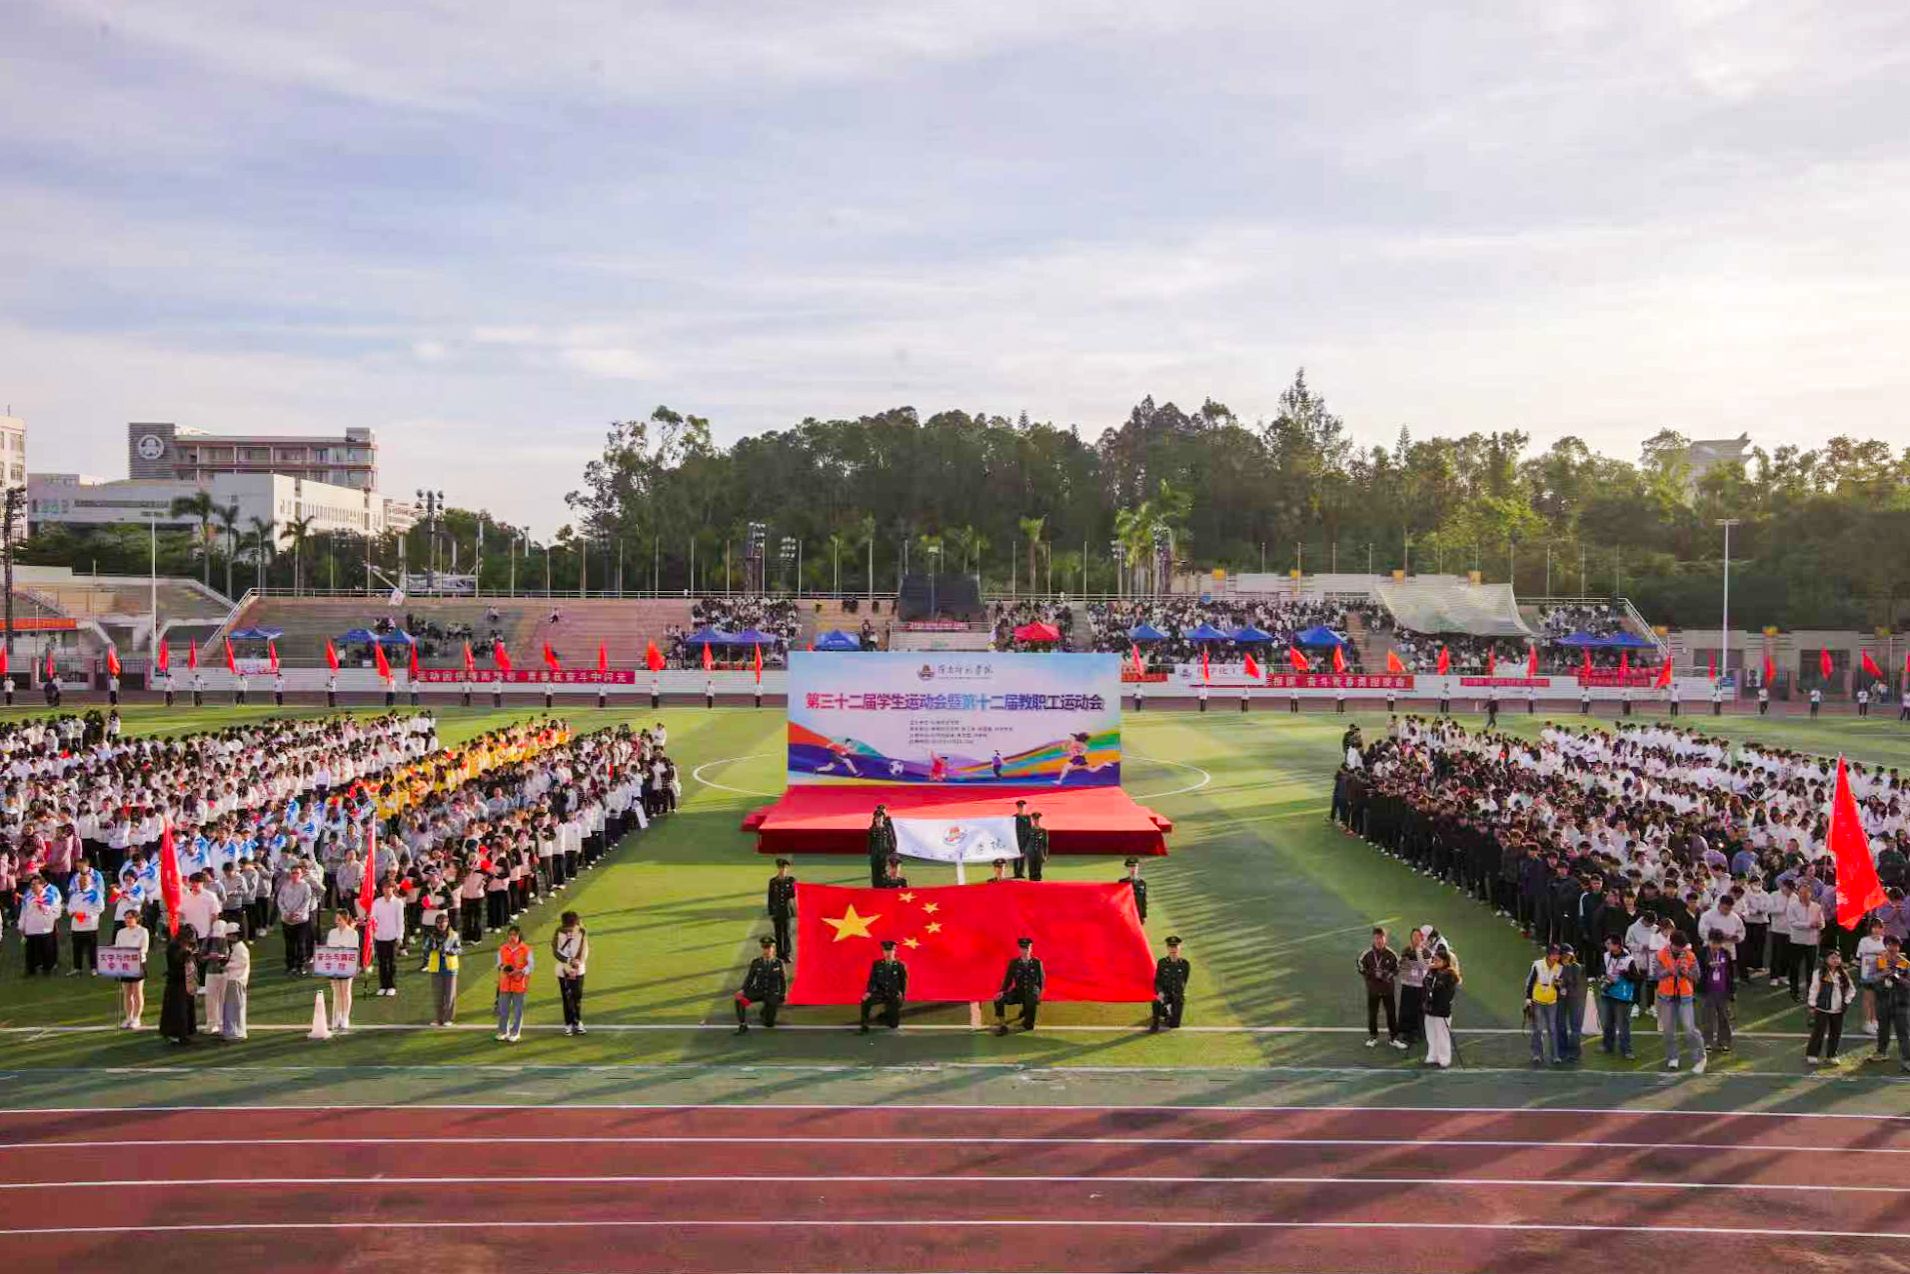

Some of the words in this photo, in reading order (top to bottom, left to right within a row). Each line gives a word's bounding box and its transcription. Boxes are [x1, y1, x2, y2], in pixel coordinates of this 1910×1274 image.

[806, 692, 1104, 711] 第三十二届学生运动会暨第十二届教职工运动会
